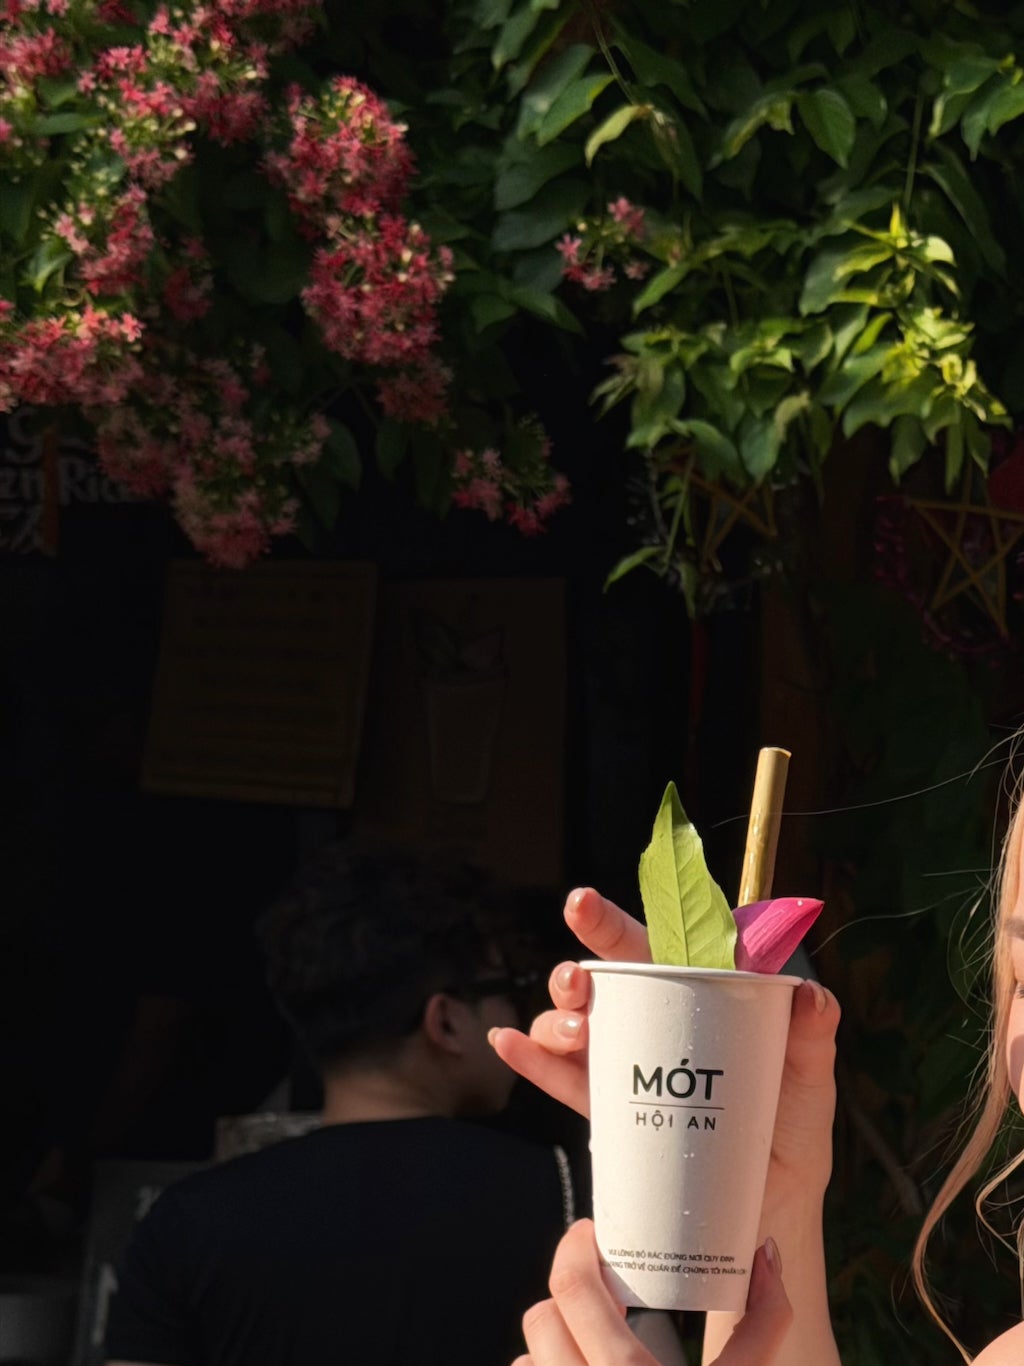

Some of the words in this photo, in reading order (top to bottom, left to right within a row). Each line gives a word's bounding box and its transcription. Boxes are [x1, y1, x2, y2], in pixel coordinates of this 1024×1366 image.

[633, 1058, 724, 1100] MÓT
[636, 1110, 673, 1131] HỘI
[687, 1116, 716, 1131] AN
